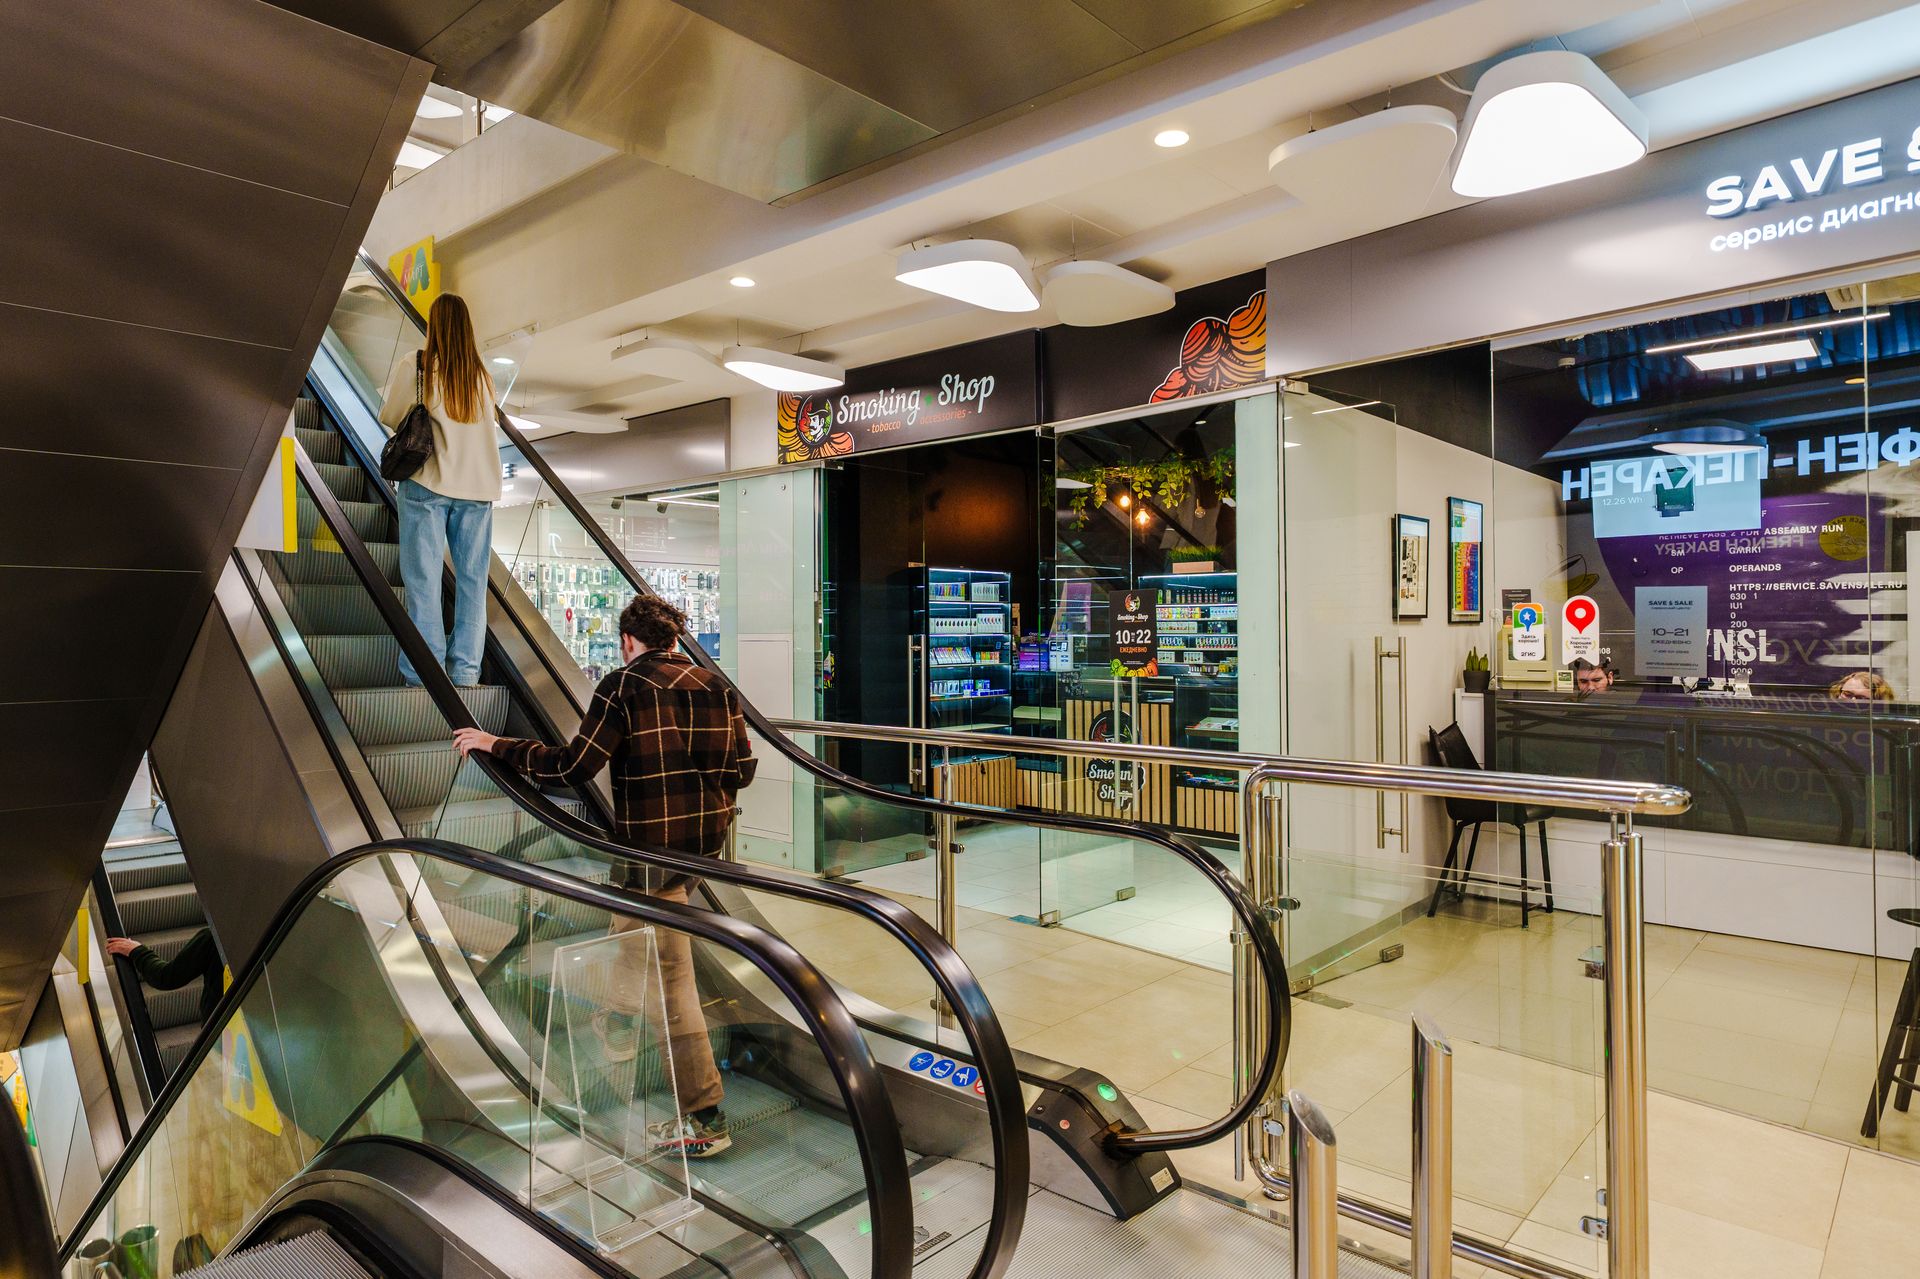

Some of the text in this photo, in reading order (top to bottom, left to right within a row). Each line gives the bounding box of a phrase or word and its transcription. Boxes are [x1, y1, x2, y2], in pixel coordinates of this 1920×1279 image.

[1706, 137, 1883, 216] SAVE
[1710, 190, 1920, 251] сервис диагн
[836, 373, 995, 425] Smoking Shop
[871, 408, 967, 434] tobacco accessories
[1602, 496, 1643, 506] 12.26 Wh
[1764, 525, 1817, 536] ASSEMBLY
[1821, 524, 1844, 533] RUN
[1671, 563, 1782, 574] OP OPERANDS
[1730, 592, 1747, 600] 630
[1730, 620, 1748, 628] 200
[1707, 628, 1777, 662] NSL
[1099, 784, 1129, 807] Shp
